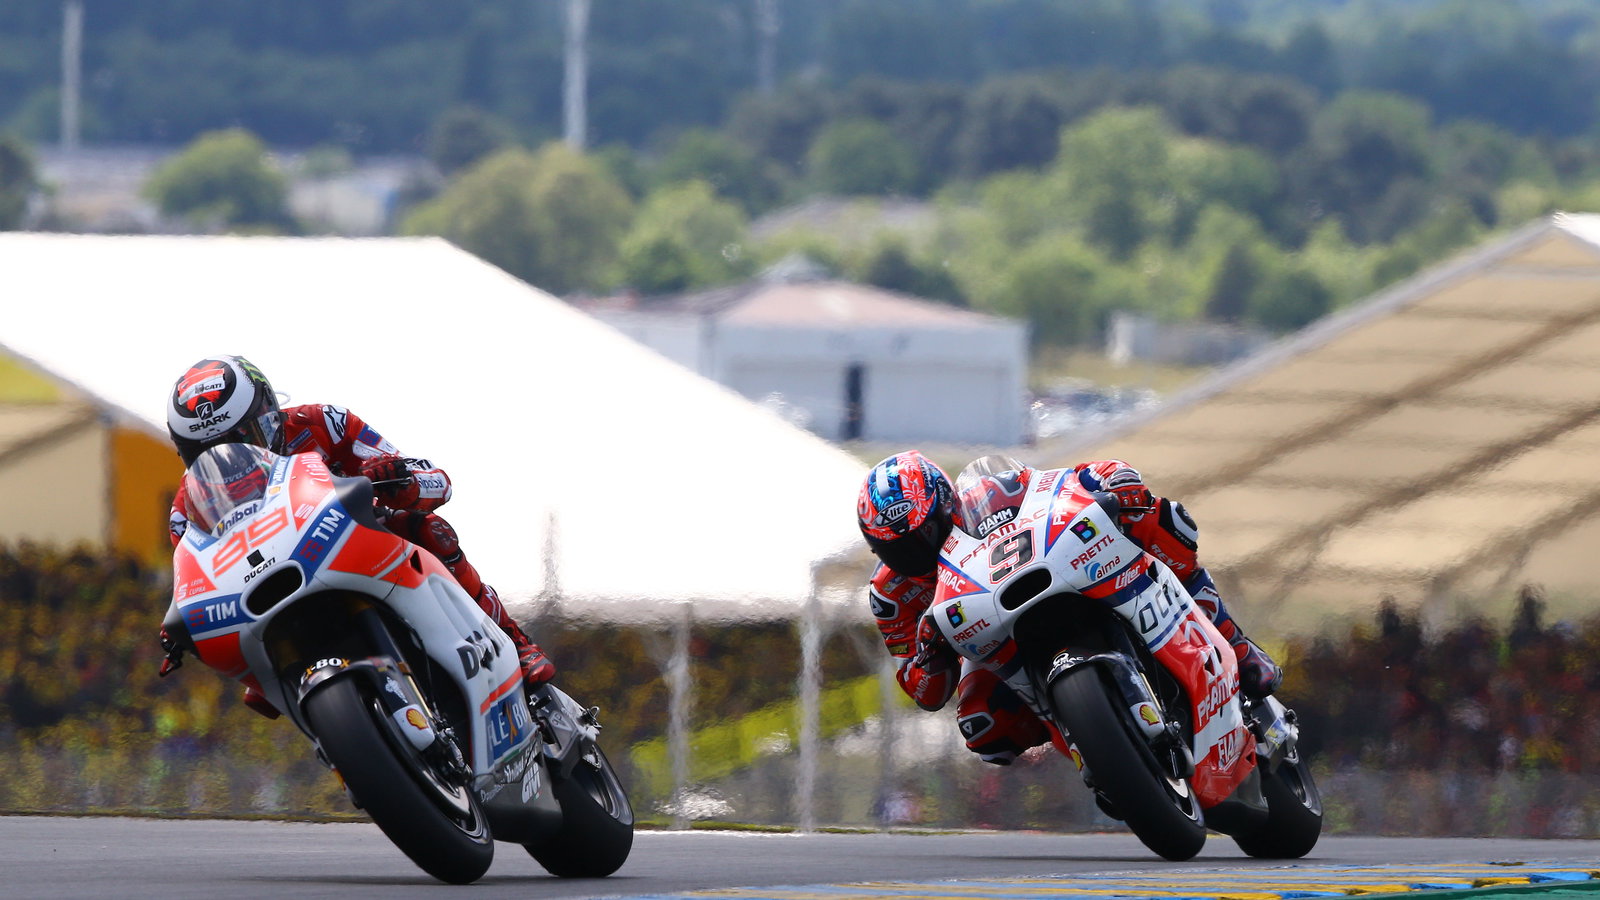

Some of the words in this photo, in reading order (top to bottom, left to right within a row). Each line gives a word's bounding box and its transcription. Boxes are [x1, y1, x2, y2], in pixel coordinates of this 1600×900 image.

[188, 410, 231, 433] SHARK
[216, 503, 258, 537] Unibat
[312, 508, 345, 542] TIM
[878, 503, 912, 525] X-lite
[977, 508, 1014, 536] FIAMM
[959, 508, 1047, 569] PRAMAC
[1069, 534, 1115, 571] PRETTL
[989, 526, 1036, 585] 9
[243, 556, 276, 584] DUCATI
[205, 601, 237, 623] TIM
[952, 618, 991, 644] PRETTL
